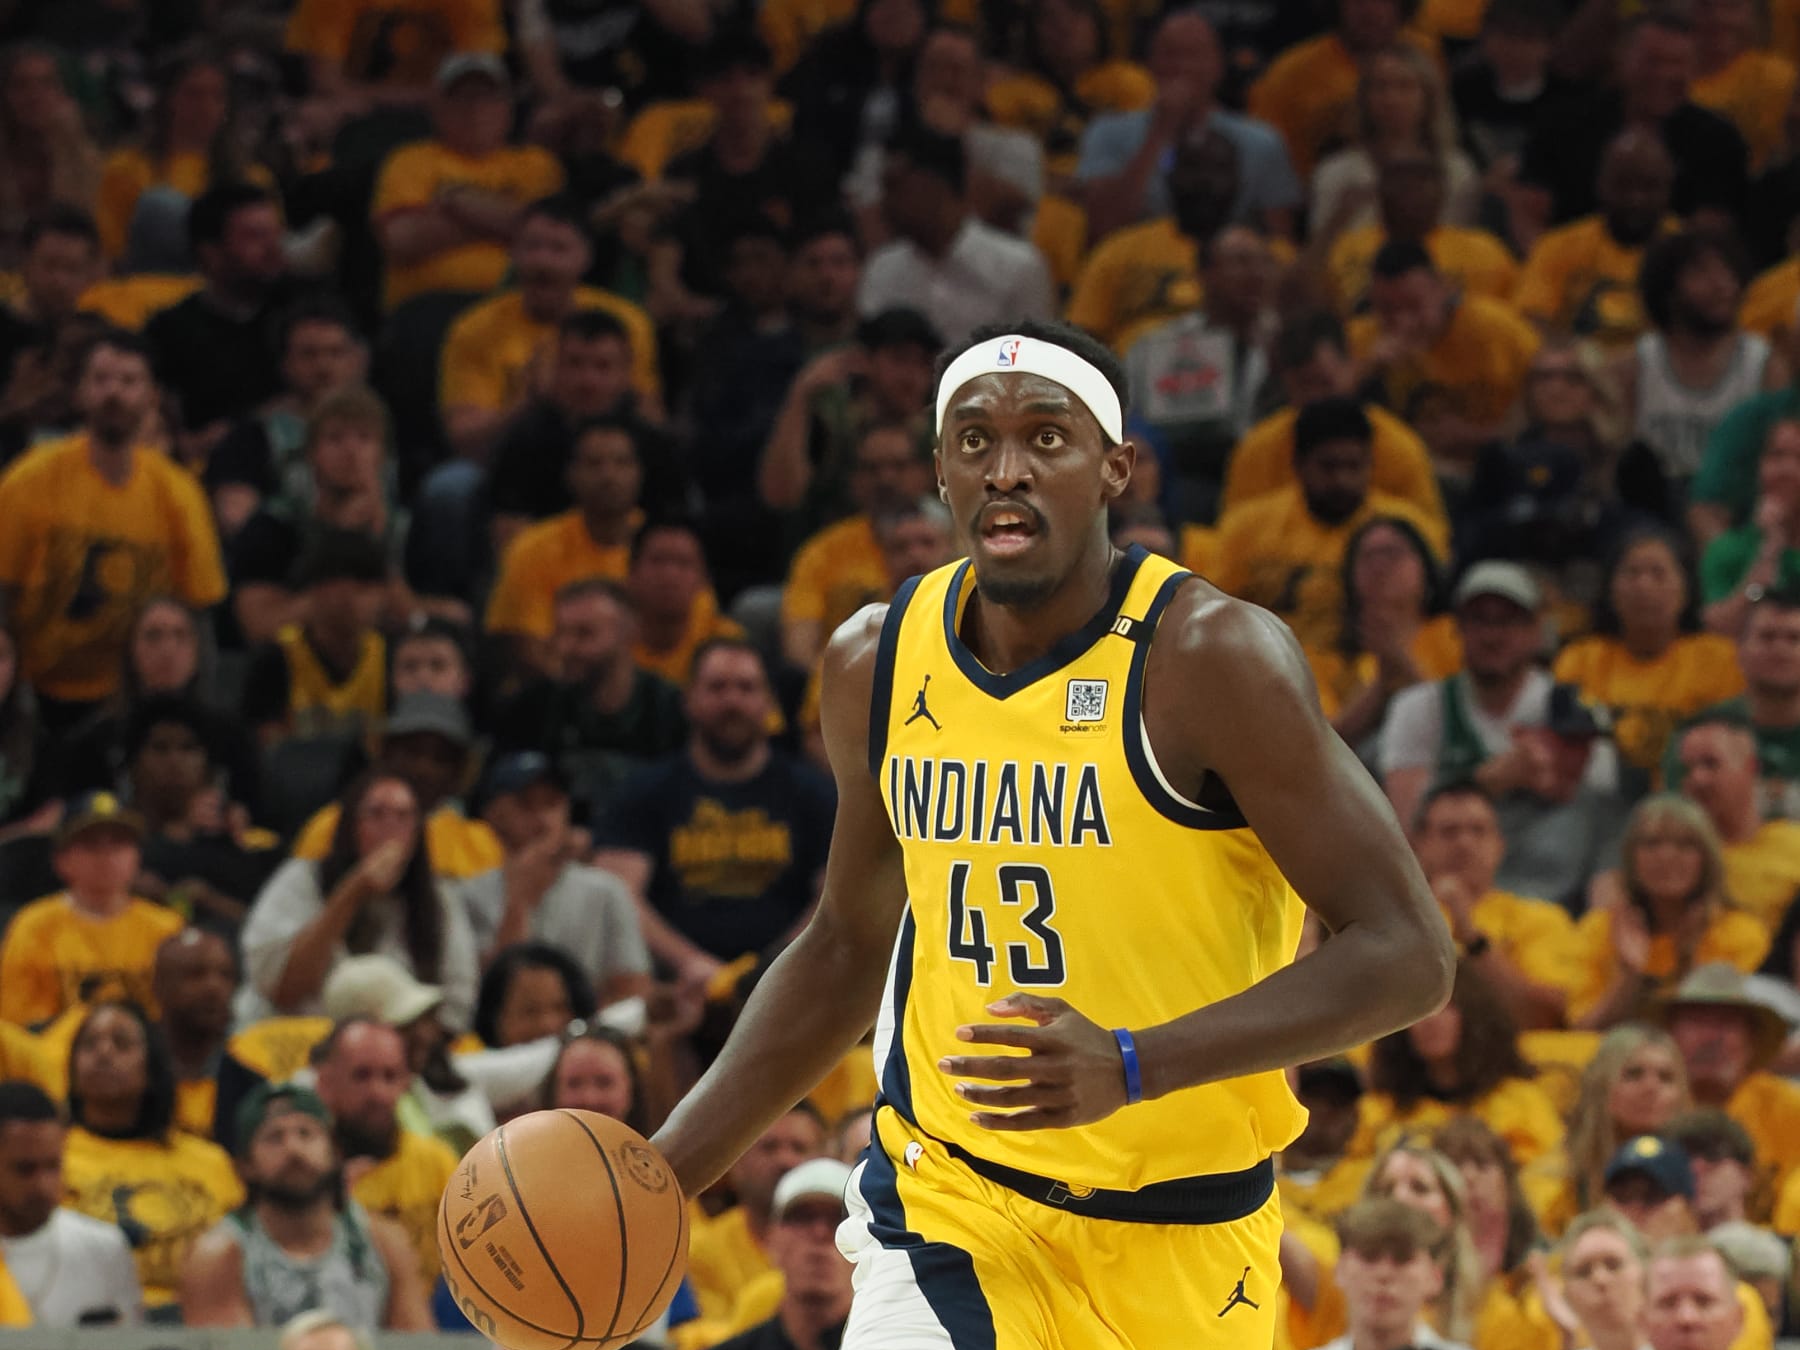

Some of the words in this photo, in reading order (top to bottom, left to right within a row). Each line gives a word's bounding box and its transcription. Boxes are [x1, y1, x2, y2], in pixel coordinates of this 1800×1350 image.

[1059, 723, 1107, 734] spokenote
[889, 756, 1113, 847] INDIANA
[948, 860, 1069, 987] 43
